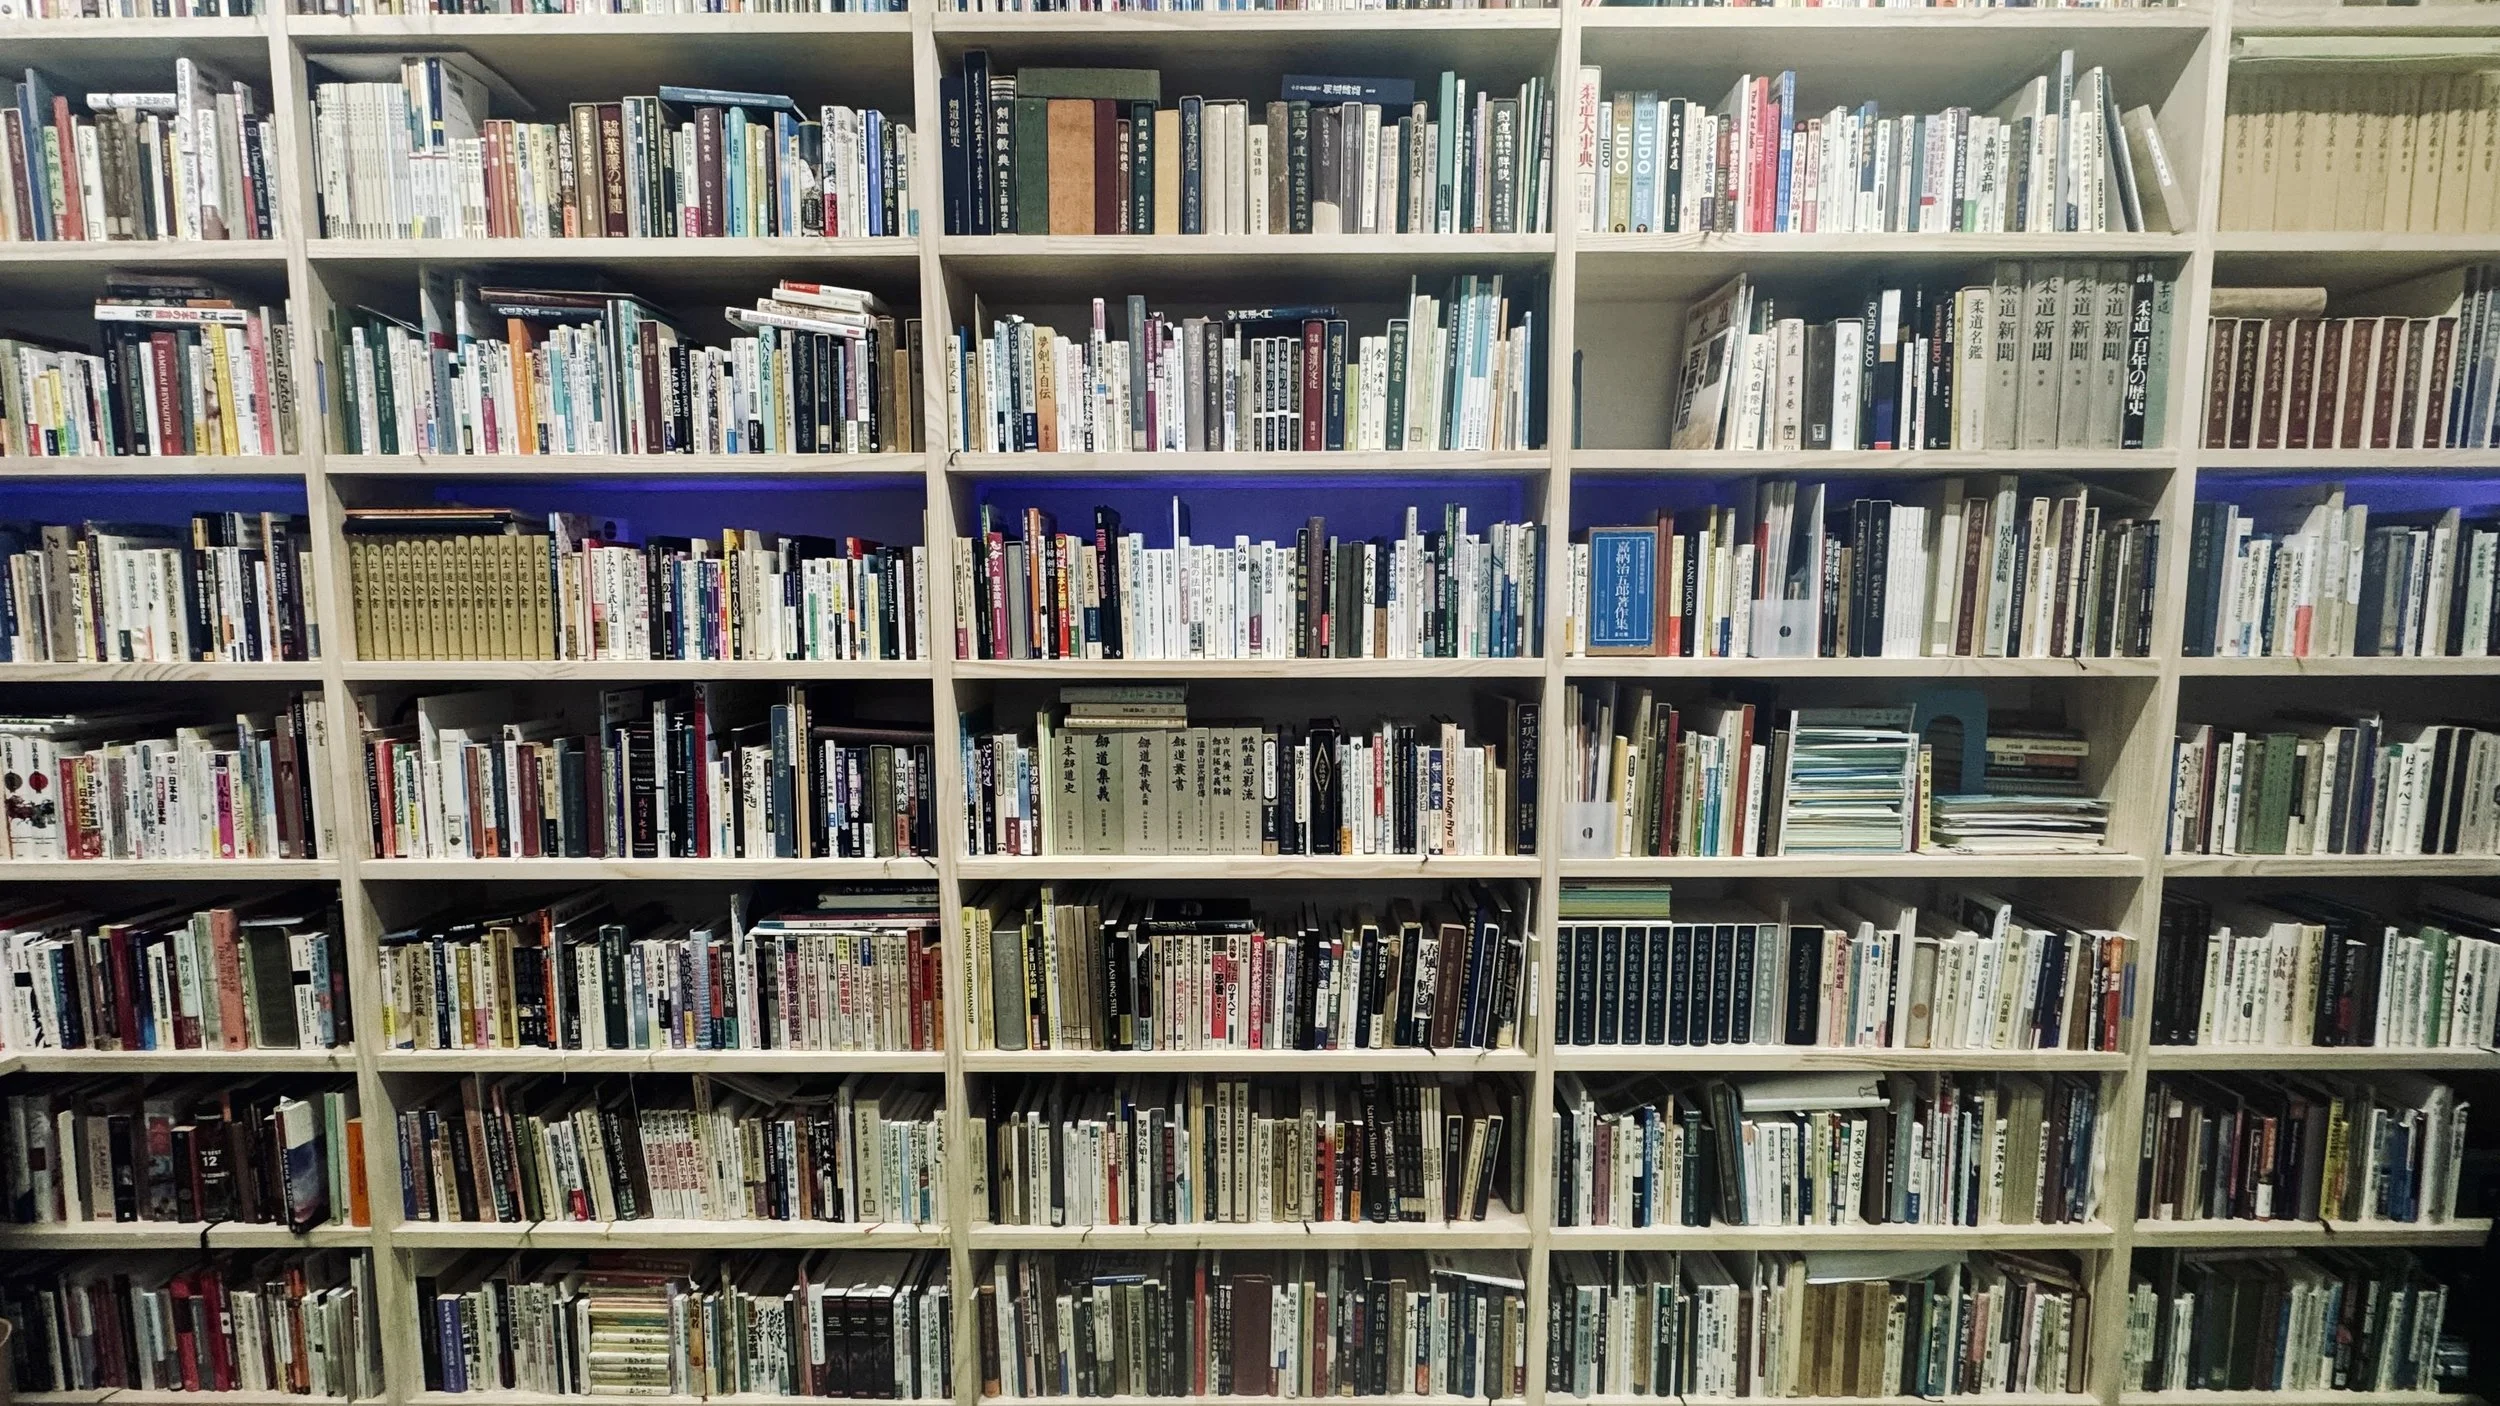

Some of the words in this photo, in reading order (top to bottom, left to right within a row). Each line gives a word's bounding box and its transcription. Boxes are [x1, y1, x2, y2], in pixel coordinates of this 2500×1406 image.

[950, 99, 961, 148] 剣道の歴史
[1579, 82, 1596, 170] 柔道大事典
[898, 155, 907, 190] 武士道
[1614, 124, 1631, 175] JUDO
[1637, 124, 1653, 175] JUDO
[1981, 141, 1997, 193] 嘉納治五郎
[272, 327, 288, 367] Samurai
[1787, 323, 1799, 357] 柔道
[1867, 301, 1878, 343] FIGHTING
[1967, 298, 1985, 360] 柔道名鑑
[1037, 336, 1051, 402] 夢剣士自伝
[1865, 344, 1876, 368] JUDO
[2129, 300, 2153, 416] 柔道百年の歴史
[159, 350, 167, 388] SAMURAI
[163, 389, 173, 436] REVOLUTION
[277, 367, 293, 414] Sketches
[671, 367, 681, 417] HARA-KIRI
[281, 562, 289, 594] SAMURAI
[351, 546, 363, 610] 武士道全書
[367, 546, 380, 610] 武士道全書
[384, 546, 397, 610] 武士道全書
[398, 546, 412, 610] 武士道全書
[412, 546, 425, 610] 武士道全書
[427, 546, 441, 610] 武士道全書
[443, 546, 456, 610] 武士道全書
[457, 546, 470, 610] 武士道全書
[472, 546, 485, 610] 武士道全書
[485, 546, 498, 610] 武士道全書
[501, 546, 514, 610] 武士道全書
[518, 546, 530, 610] 武士道全書
[536, 546, 548, 610] 武士道全書
[1046, 541, 1056, 577] 日韓剣道
[1237, 544, 1247, 573] 気の剣
[1687, 560, 1695, 584] KANO
[887, 567, 895, 605] Unfettered
[1614, 539, 1631, 630] 嘉納治五郎著作集
[1685, 585, 1693, 616] JIGORO
[1521, 713, 1537, 780] 示現流兵法
[367, 751, 377, 791] SAMURAI
[373, 801, 381, 826] NINJA
[895, 758, 908, 815] 山岡鉄舟
[1241, 754, 1257, 802] 直心影流
[1446, 776, 1455, 796] Shin
[1445, 797, 1455, 820] Kage
[1446, 820, 1454, 837] Ryu
[964, 927, 972, 960] JAPANESE
[965, 961, 975, 1025] SWORDSMANSHIP
[1109, 960, 1117, 997] FLASHING
[1366, 1104, 1375, 1127] Katori
[203, 1156, 218, 1167] 12
